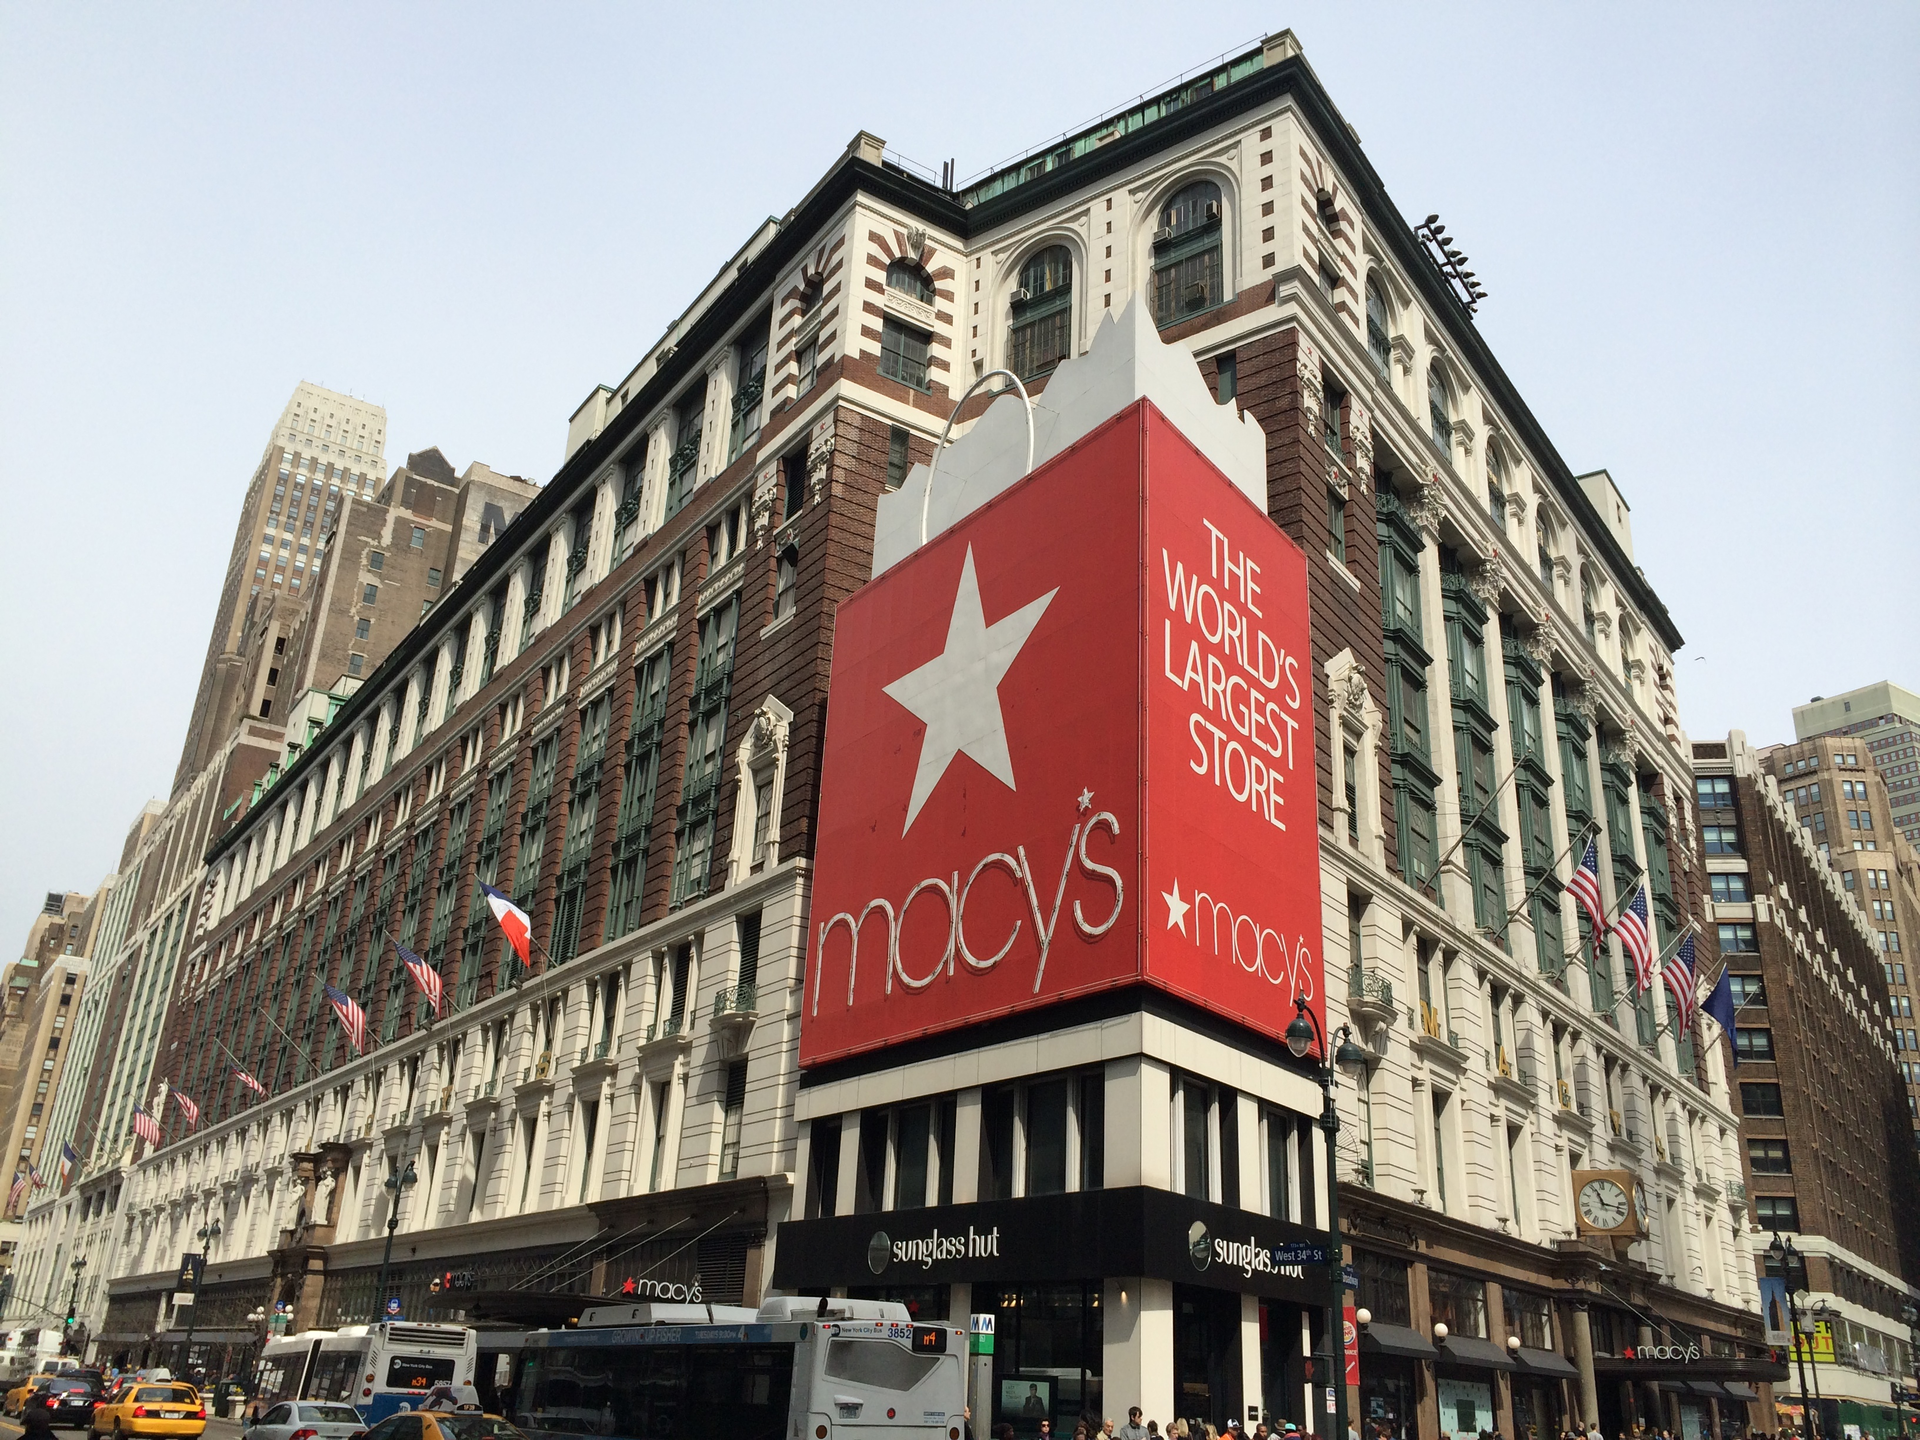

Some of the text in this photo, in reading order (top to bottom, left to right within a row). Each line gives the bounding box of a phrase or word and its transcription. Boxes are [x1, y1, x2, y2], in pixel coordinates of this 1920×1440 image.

[1202, 517, 1263, 619] THE
[1162, 547, 1301, 710] WORLD'S
[1164, 618, 1300, 770] LARGEST
[1189, 713, 1287, 832] STORE
[811, 788, 1125, 1017] macy's
[1194, 889, 1314, 1007] macy's
[893, 1225, 999, 1270] sunglass hut
[1274, 1249, 1322, 1261] West 34th St
[637, 1279, 702, 1304] macy's
[656, 1328, 682, 1342] FISHER
[887, 1327, 911, 1339] 3852
[923, 1332, 936, 1345] M4
[1637, 1342, 1700, 1364] macy's
